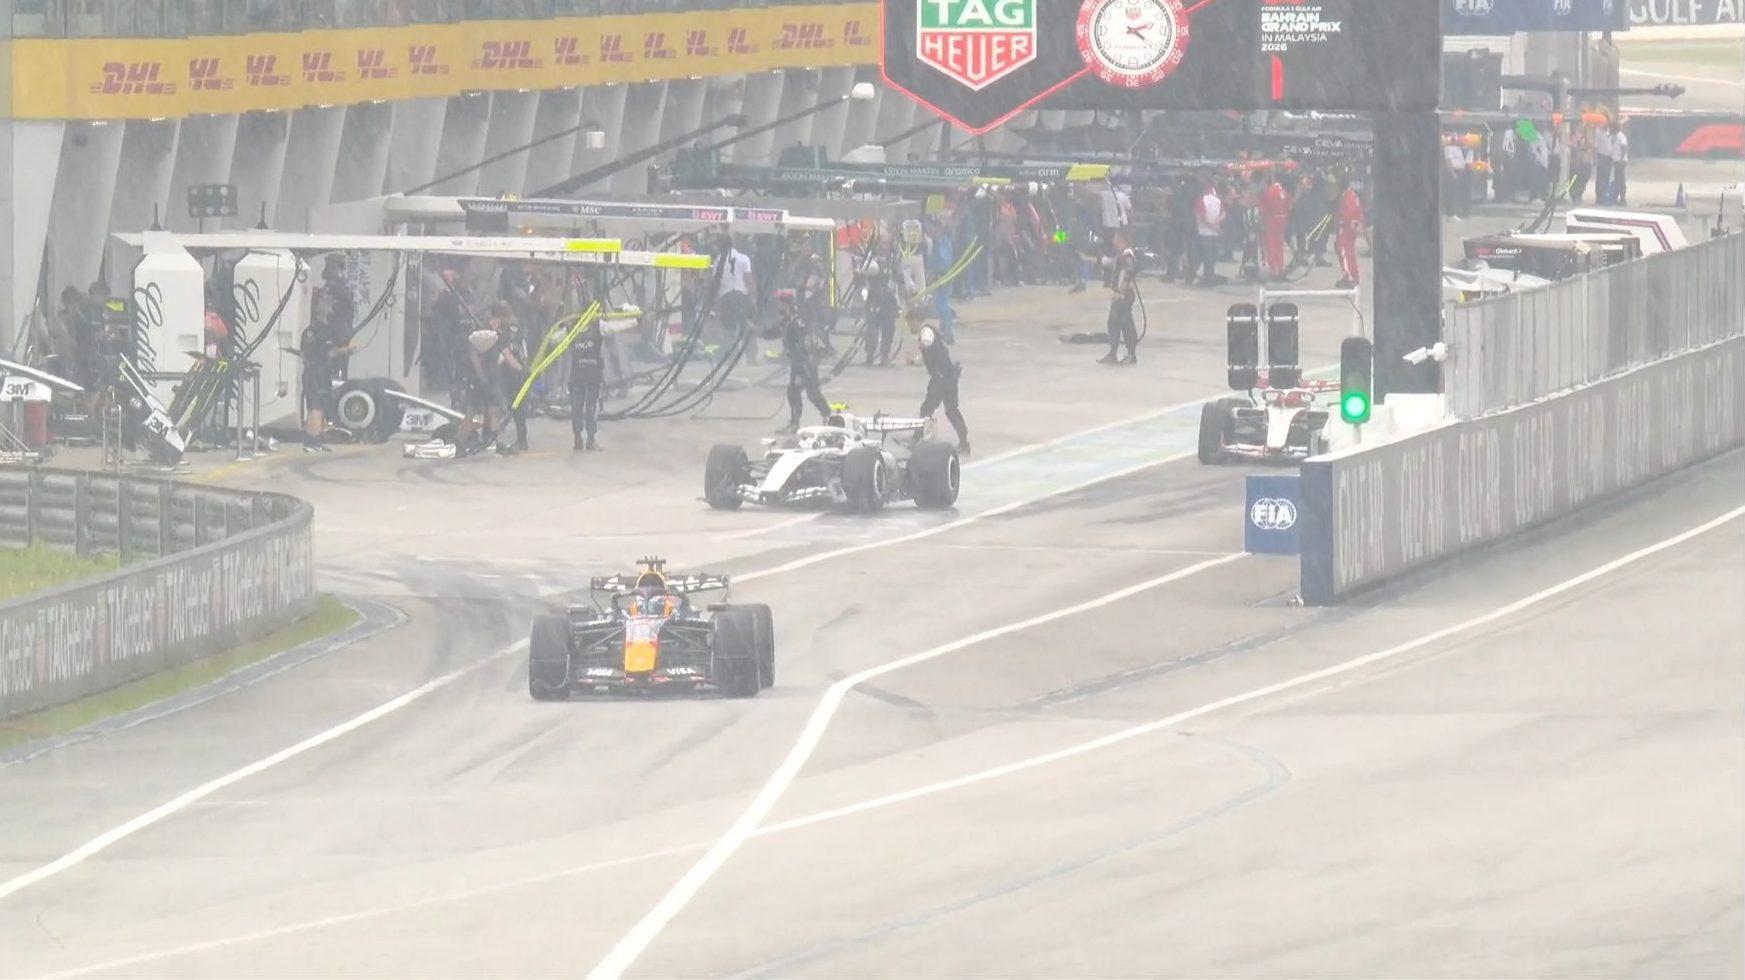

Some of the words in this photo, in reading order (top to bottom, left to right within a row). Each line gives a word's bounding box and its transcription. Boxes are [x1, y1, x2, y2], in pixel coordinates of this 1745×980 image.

[928, 0, 1025, 25] TAG
[1262, 13, 1320, 22] BAHRAIN
[1630, 0, 1696, 24] GULF
[1715, 0, 1745, 23] AI
[1262, 23, 1309, 32] GRAND
[1311, 22, 1341, 32] PRIX
[1262, 34, 1273, 42] IN
[1275, 34, 1328, 42] MALAYSIA
[103, 62, 164, 94] DHL
[482, 40, 534, 69] DHL
[782, 23, 827, 49] DHL
[924, 34, 1030, 81] HEUER
[944, 167, 981, 177] aramco
[1038, 168, 1060, 178] arm
[581, 205, 603, 216] MSC
[6, 383, 30, 396] 3M
[406, 414, 429, 426] 3M
[151, 417, 168, 437] 3M
[667, 667, 697, 675] VISA
